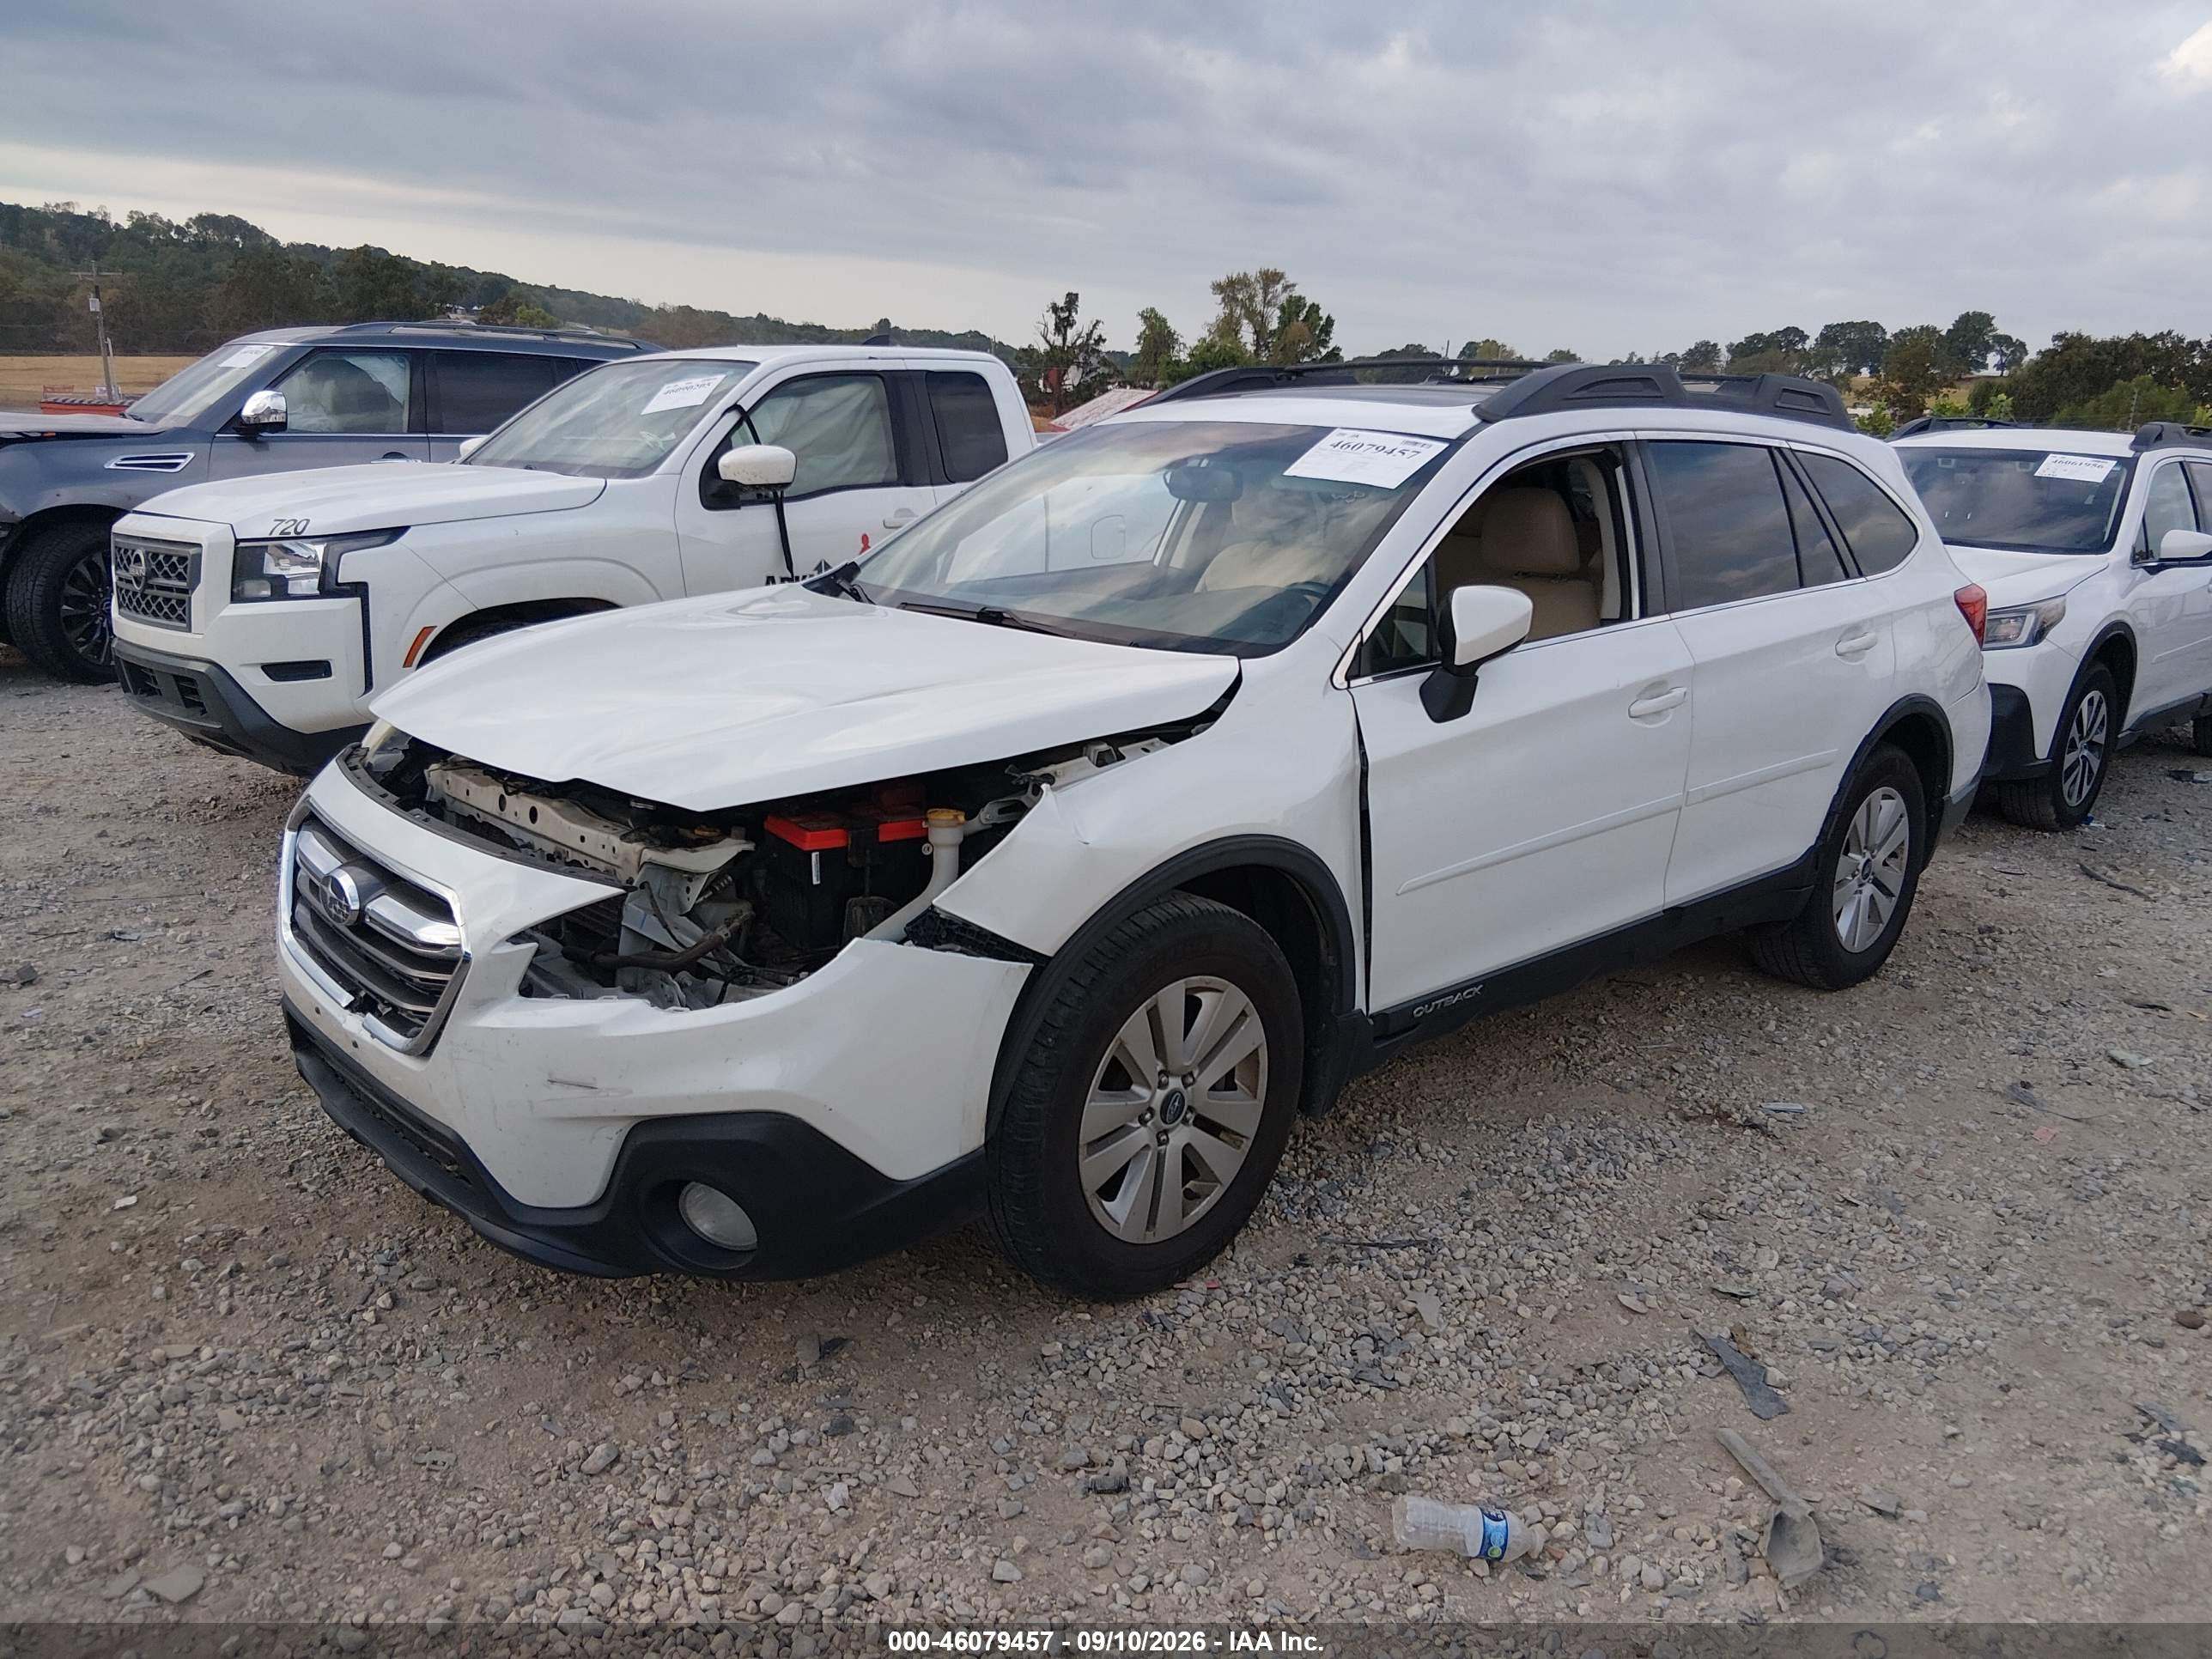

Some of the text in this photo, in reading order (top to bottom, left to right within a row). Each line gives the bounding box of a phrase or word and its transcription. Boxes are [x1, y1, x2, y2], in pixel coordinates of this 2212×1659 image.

[1329, 440, 1422, 459] 46079457
[268, 518, 311, 536] 720
[1413, 984, 1484, 1018] OUTBACK
